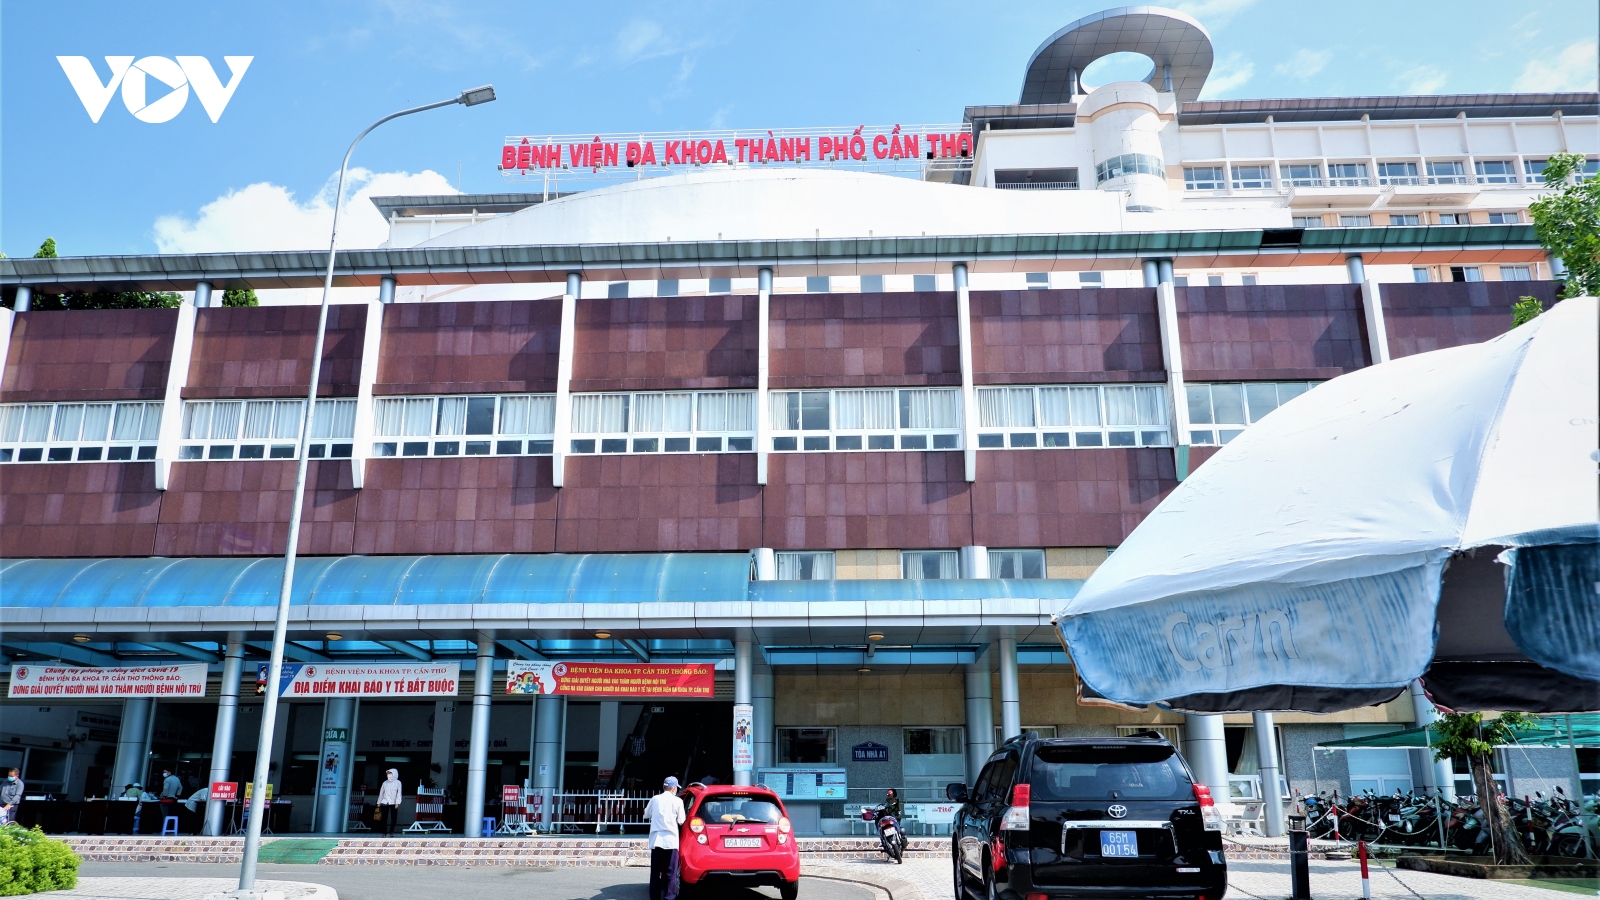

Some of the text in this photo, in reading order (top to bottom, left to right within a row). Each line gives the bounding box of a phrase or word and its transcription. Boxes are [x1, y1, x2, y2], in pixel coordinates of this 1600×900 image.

[502, 124, 973, 175] BỆNH VIỆN ĐA KHOA THÀNH PHỐ CẦN THƠ
[325, 667, 345, 676] BỆNH
[348, 667, 366, 676] VIỆN
[414, 666, 429, 675] CẦN
[570, 666, 587, 675] BỆNH
[588, 666, 603, 675] VIỆN
[642, 665, 656, 674] CẦN
[671, 667, 692, 675] THÔNG
[39, 675, 55, 683] BỆNH
[111, 673, 125, 682] CẦN
[31, 683, 43, 694] GIẢI
[44, 683, 63, 695] QUYẾT
[65, 684, 84, 694] NGƯỜI
[86, 683, 99, 694] NHÀ
[101, 683, 113, 694] VÀO
[135, 683, 155, 694] NGƯỜI
[156, 683, 174, 695] BỆNH
[175, 683, 187, 695] NỘI
[189, 682, 202, 694] TRÚ
[294, 677, 455, 696] ĐỊA ĐIỂM KHAI BÁO Y TẾ BẤT BUỘC
[325, 728, 345, 739] CỬA A
[855, 748, 886, 759] TÒA NHÀ A1
[1109, 832, 1129, 843] 65M
[1102, 844, 1137, 856] 001.54
